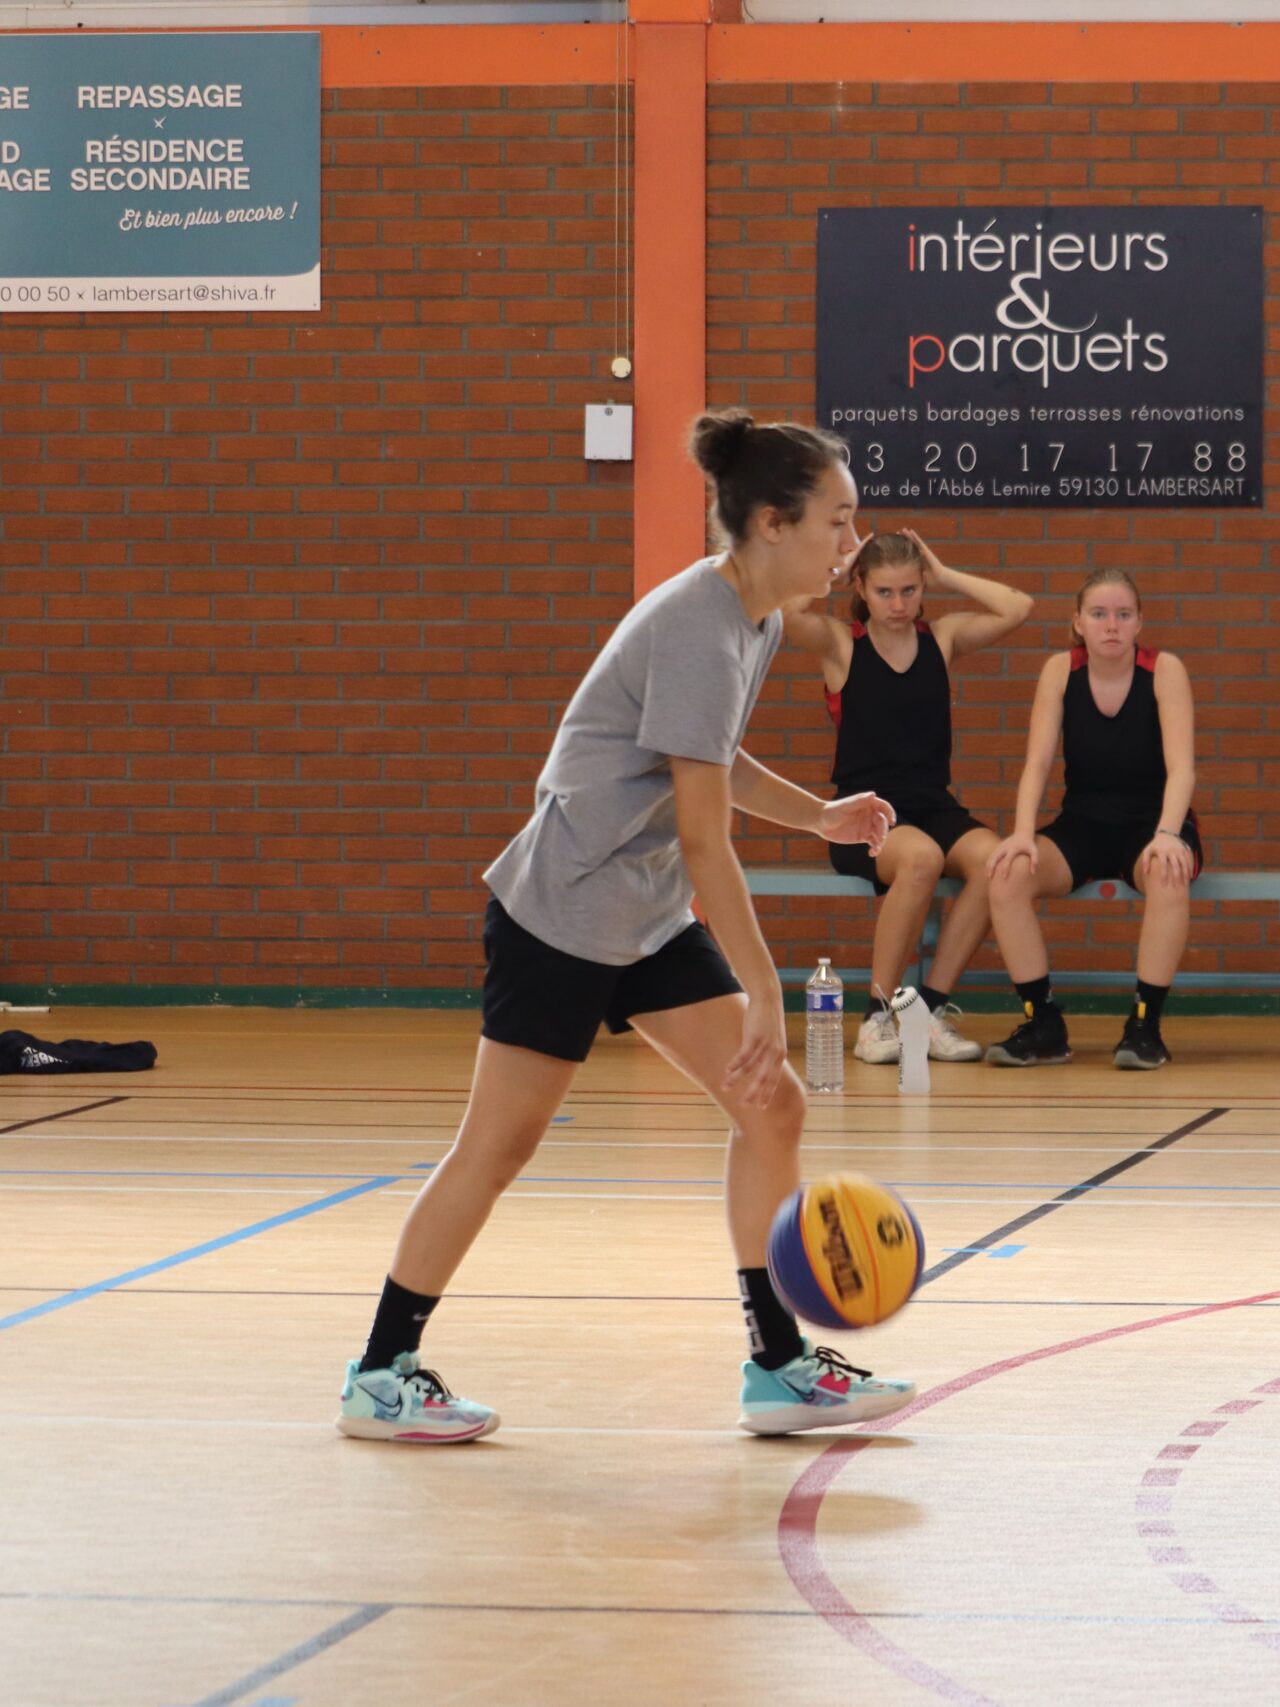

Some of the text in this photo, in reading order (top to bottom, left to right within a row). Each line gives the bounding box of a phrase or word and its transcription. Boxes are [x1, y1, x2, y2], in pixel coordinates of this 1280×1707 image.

[77, 84, 242, 109] REPASSAGE
[86, 134, 244, 163] RÉSIDENCE
[70, 166, 251, 191] SECONDAIRE
[119, 208, 143, 231] Et
[144, 210, 183, 228] bien
[183, 207, 223, 230] plus
[225, 205, 285, 224] encore
[17, 286, 42, 302] 00
[47, 285, 71, 302] 50
[92, 284, 276, 302] lambersart@shiva.fr
[996, 271, 1097, 334] &
[908, 317, 1168, 389] parquets
[831, 401, 1245, 427] parquets bardages terrasses rénovations
[924, 442, 977, 473] 20
[1020, 442, 1065, 472] 17
[1108, 442, 1153, 472] 17
[1194, 442, 1246, 473] 88
[863, 477, 1245, 497] rue de l'Abbé Lemire 59130 LAMBERSART
